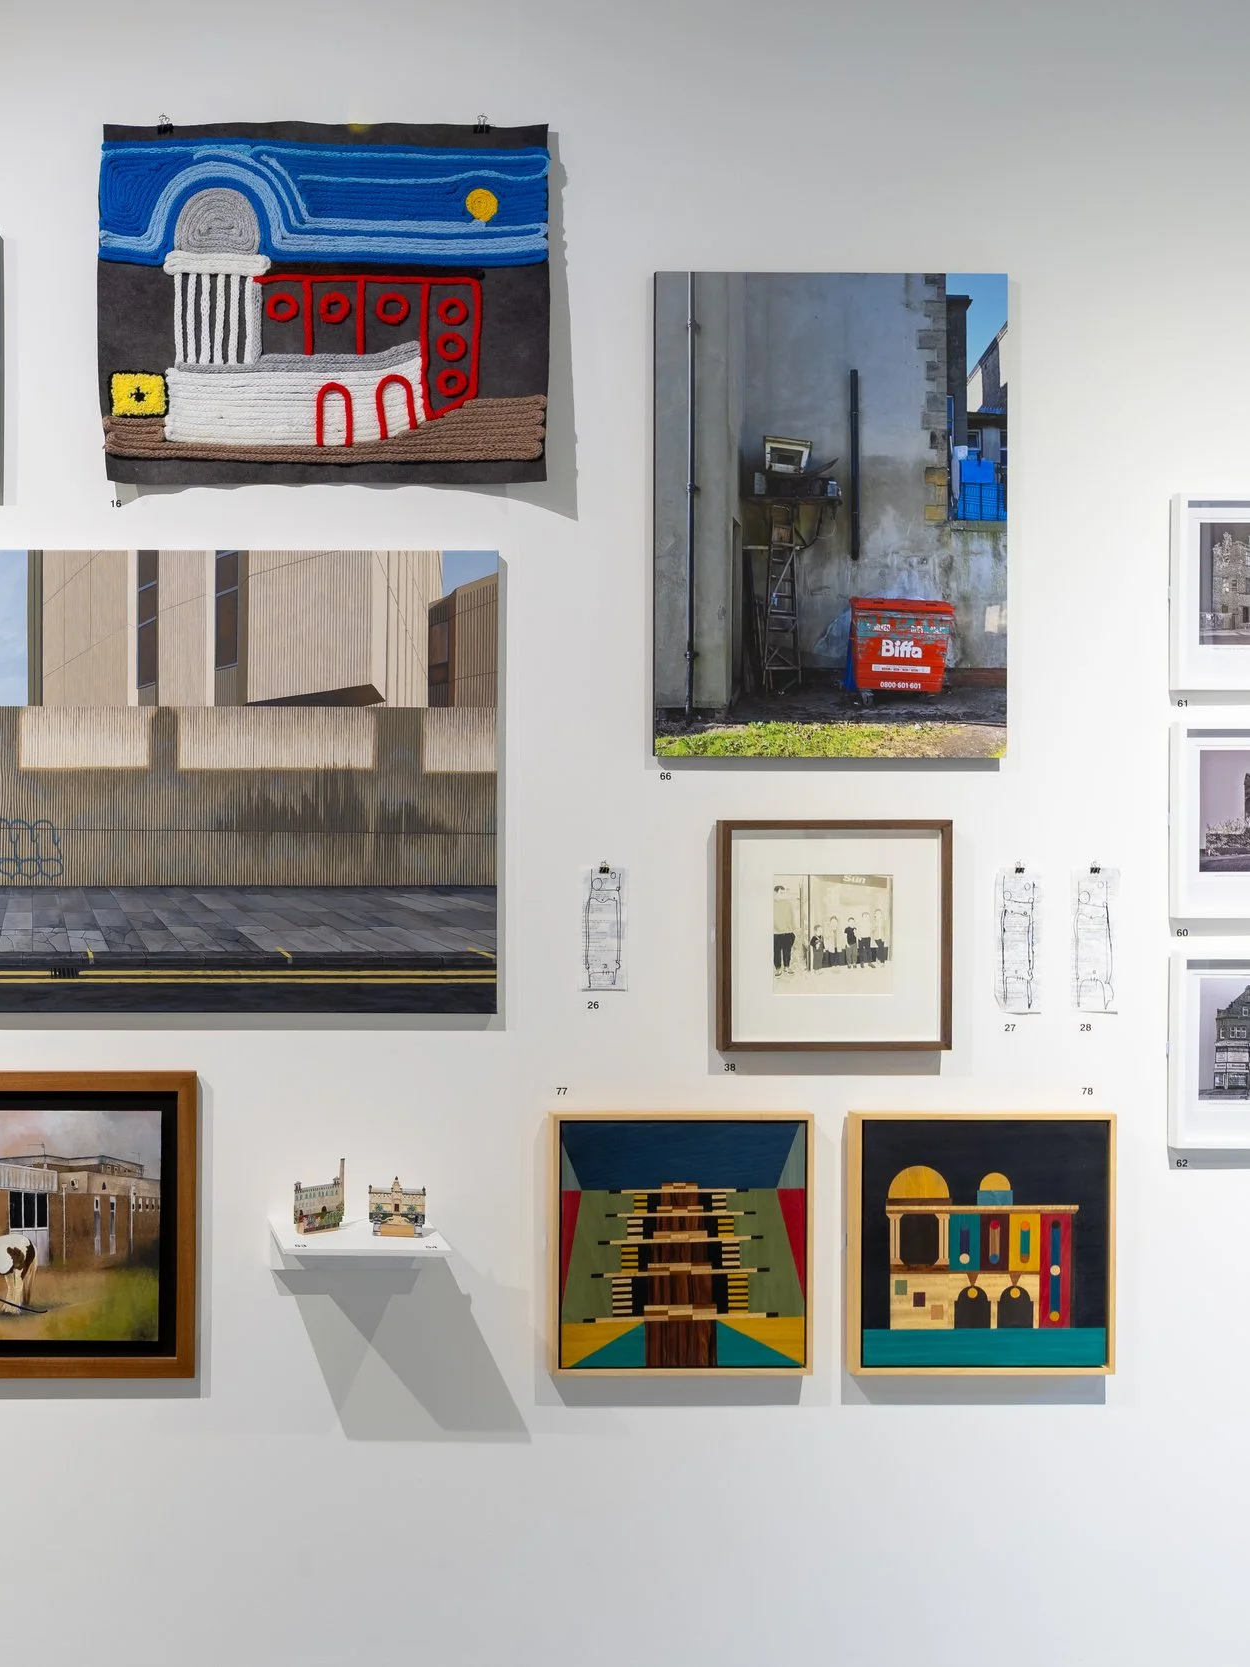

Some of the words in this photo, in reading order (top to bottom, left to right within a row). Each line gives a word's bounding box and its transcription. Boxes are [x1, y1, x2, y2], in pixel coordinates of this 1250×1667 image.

[110, 499, 122, 508] 16
[881, 640, 923, 658] Biffa
[880, 681, 897, 689] 0800
[1177, 699, 1189, 708] 61
[659, 772, 672, 781] 66
[842, 874, 866, 884] Sun
[1176, 928, 1189, 937] 60
[587, 1000, 600, 1010] 26
[1004, 1023, 1016, 1032] 27
[1079, 1023, 1092, 1032] 28
[723, 1063, 736, 1072] 38
[556, 1087, 568, 1096] 77
[1081, 1087, 1094, 1096] 78
[1176, 1158, 1188, 1168] 62
